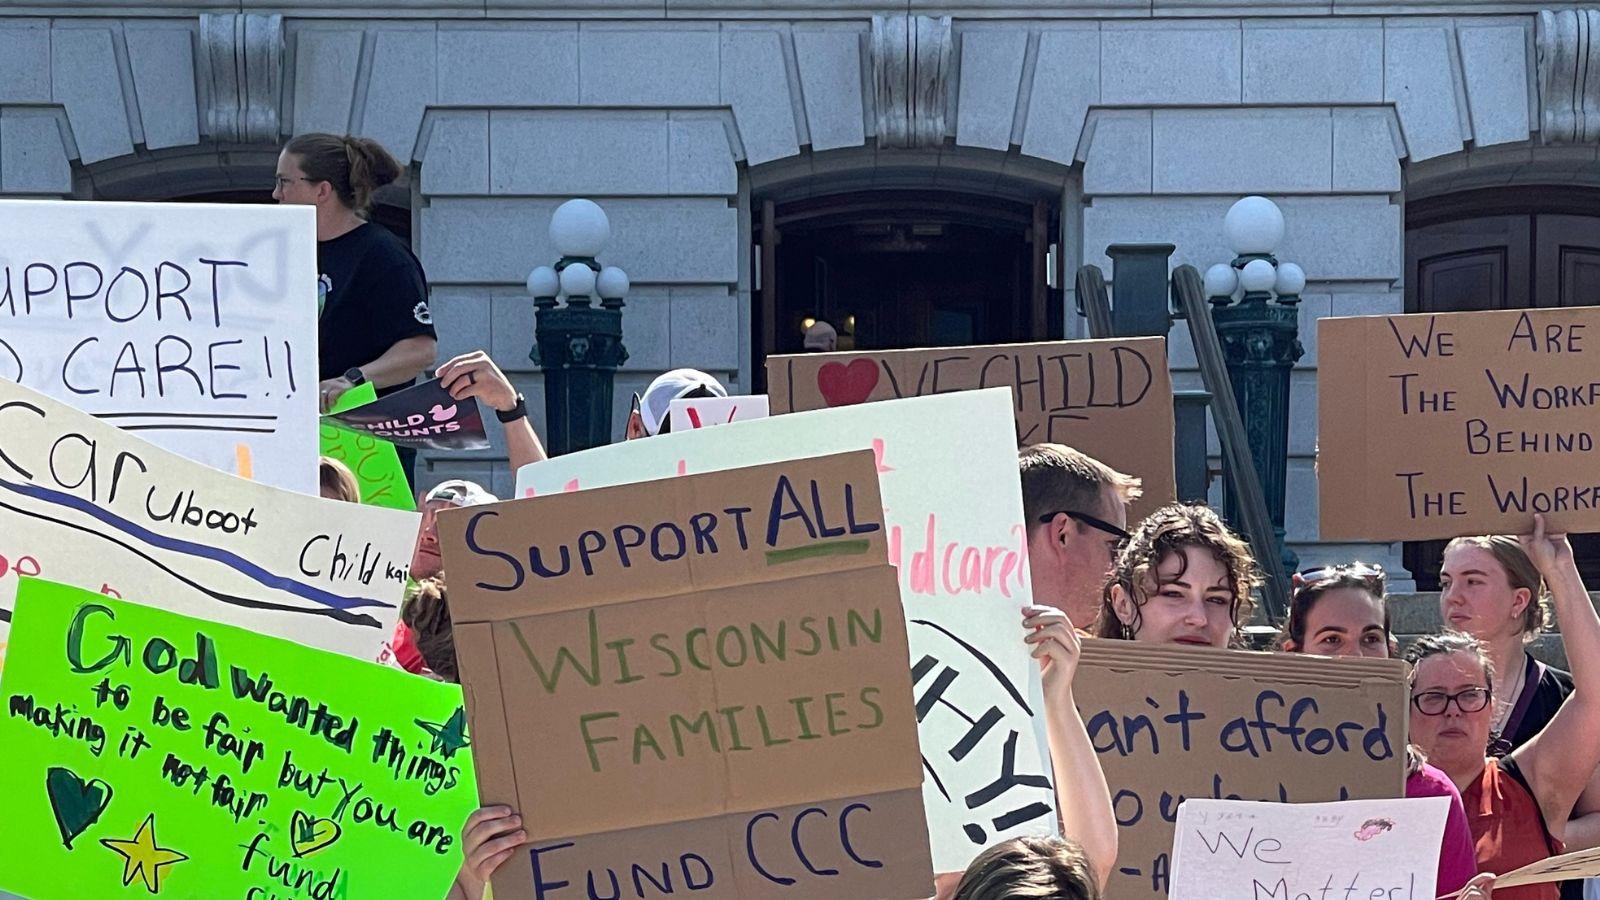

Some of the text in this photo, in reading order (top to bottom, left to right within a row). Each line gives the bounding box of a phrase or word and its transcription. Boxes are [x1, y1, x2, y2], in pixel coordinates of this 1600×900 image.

[1388, 312, 1586, 358] WE ARE
[1389, 373, 1457, 414] THE
[375, 421, 460, 437] OUNTS
[1466, 418, 1593, 455] BEHIND
[766, 474, 880, 547] ALL
[1395, 472, 1467, 518] THE
[299, 534, 381, 585] Child
[508, 607, 883, 693] WISCONSIN
[66, 603, 219, 689] God
[372, 726, 460, 796] things
[579, 686, 885, 773] FAMILIES
[1077, 689, 1394, 761] an't afford
[91, 677, 131, 711] to
[152, 695, 192, 731] be
[202, 711, 265, 774] fair
[277, 750, 337, 798] but
[407, 820, 454, 854] are
[119, 726, 152, 760] it
[161, 753, 211, 795] not
[530, 802, 884, 900] FUND CCC
[1197, 827, 1292, 864] We
